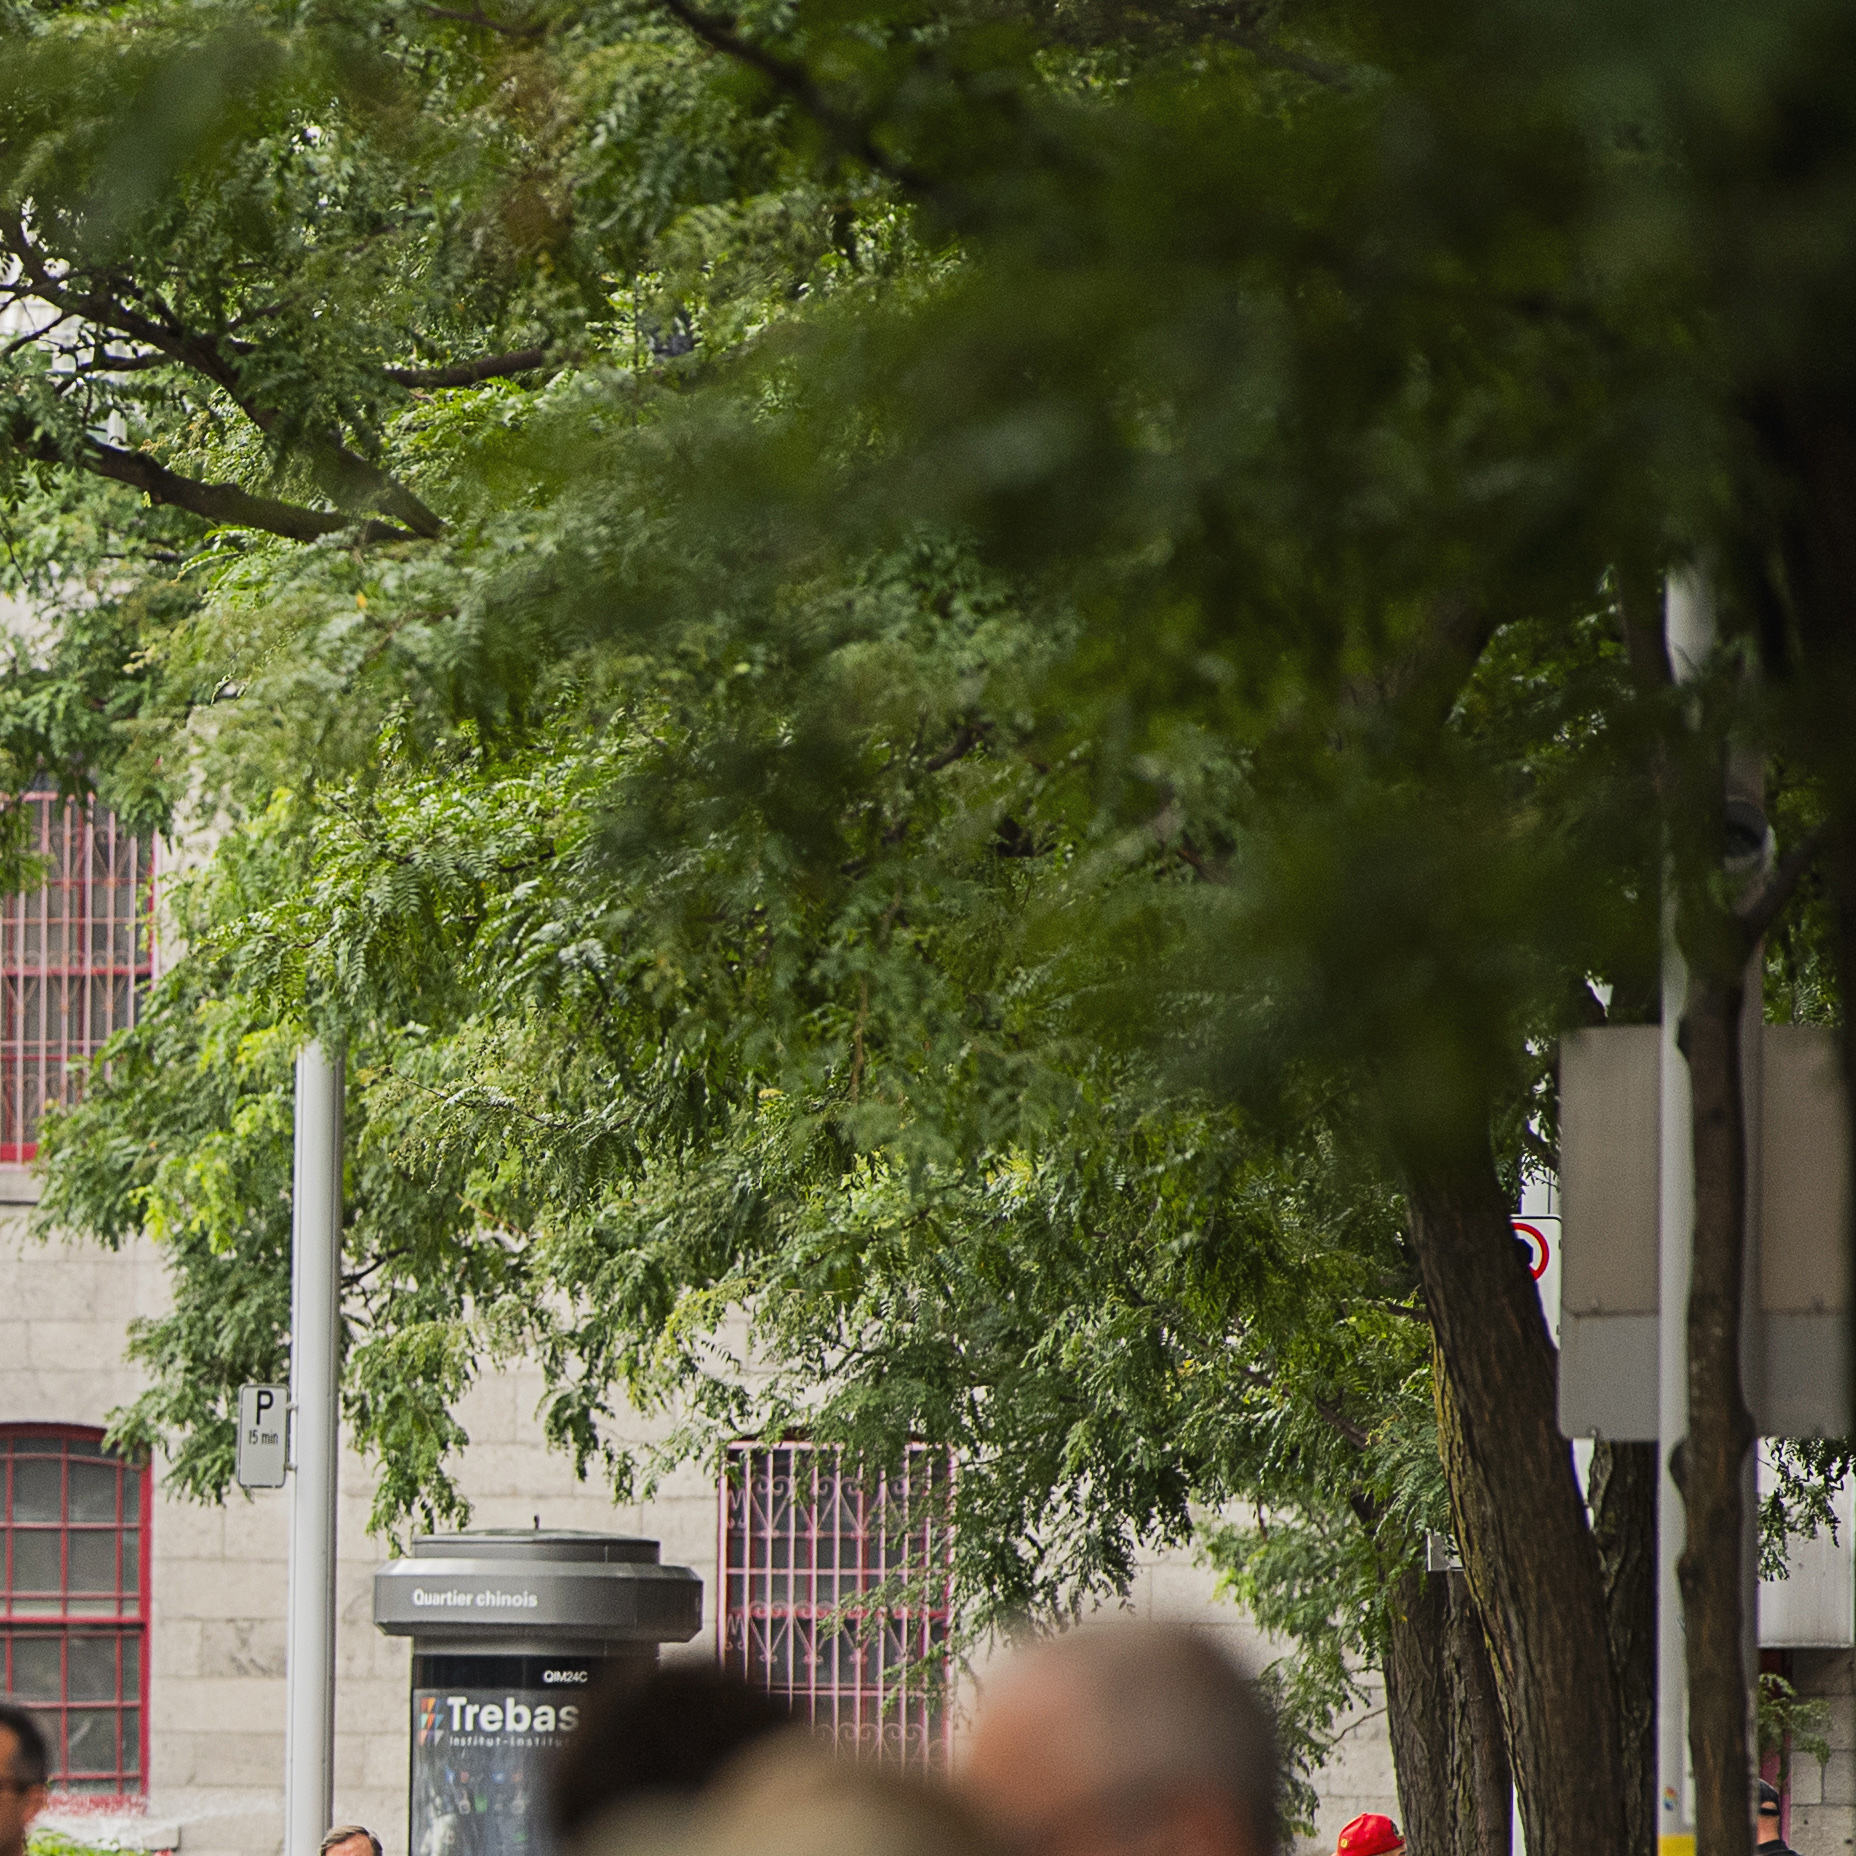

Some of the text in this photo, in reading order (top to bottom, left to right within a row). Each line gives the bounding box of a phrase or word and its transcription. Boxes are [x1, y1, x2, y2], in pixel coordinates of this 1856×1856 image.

[256, 1389, 274, 1426] P
[249, 1429, 279, 1445] 15 min
[412, 1588, 538, 1608] Quartier chinois
[446, 1696, 581, 1733] Trebas
